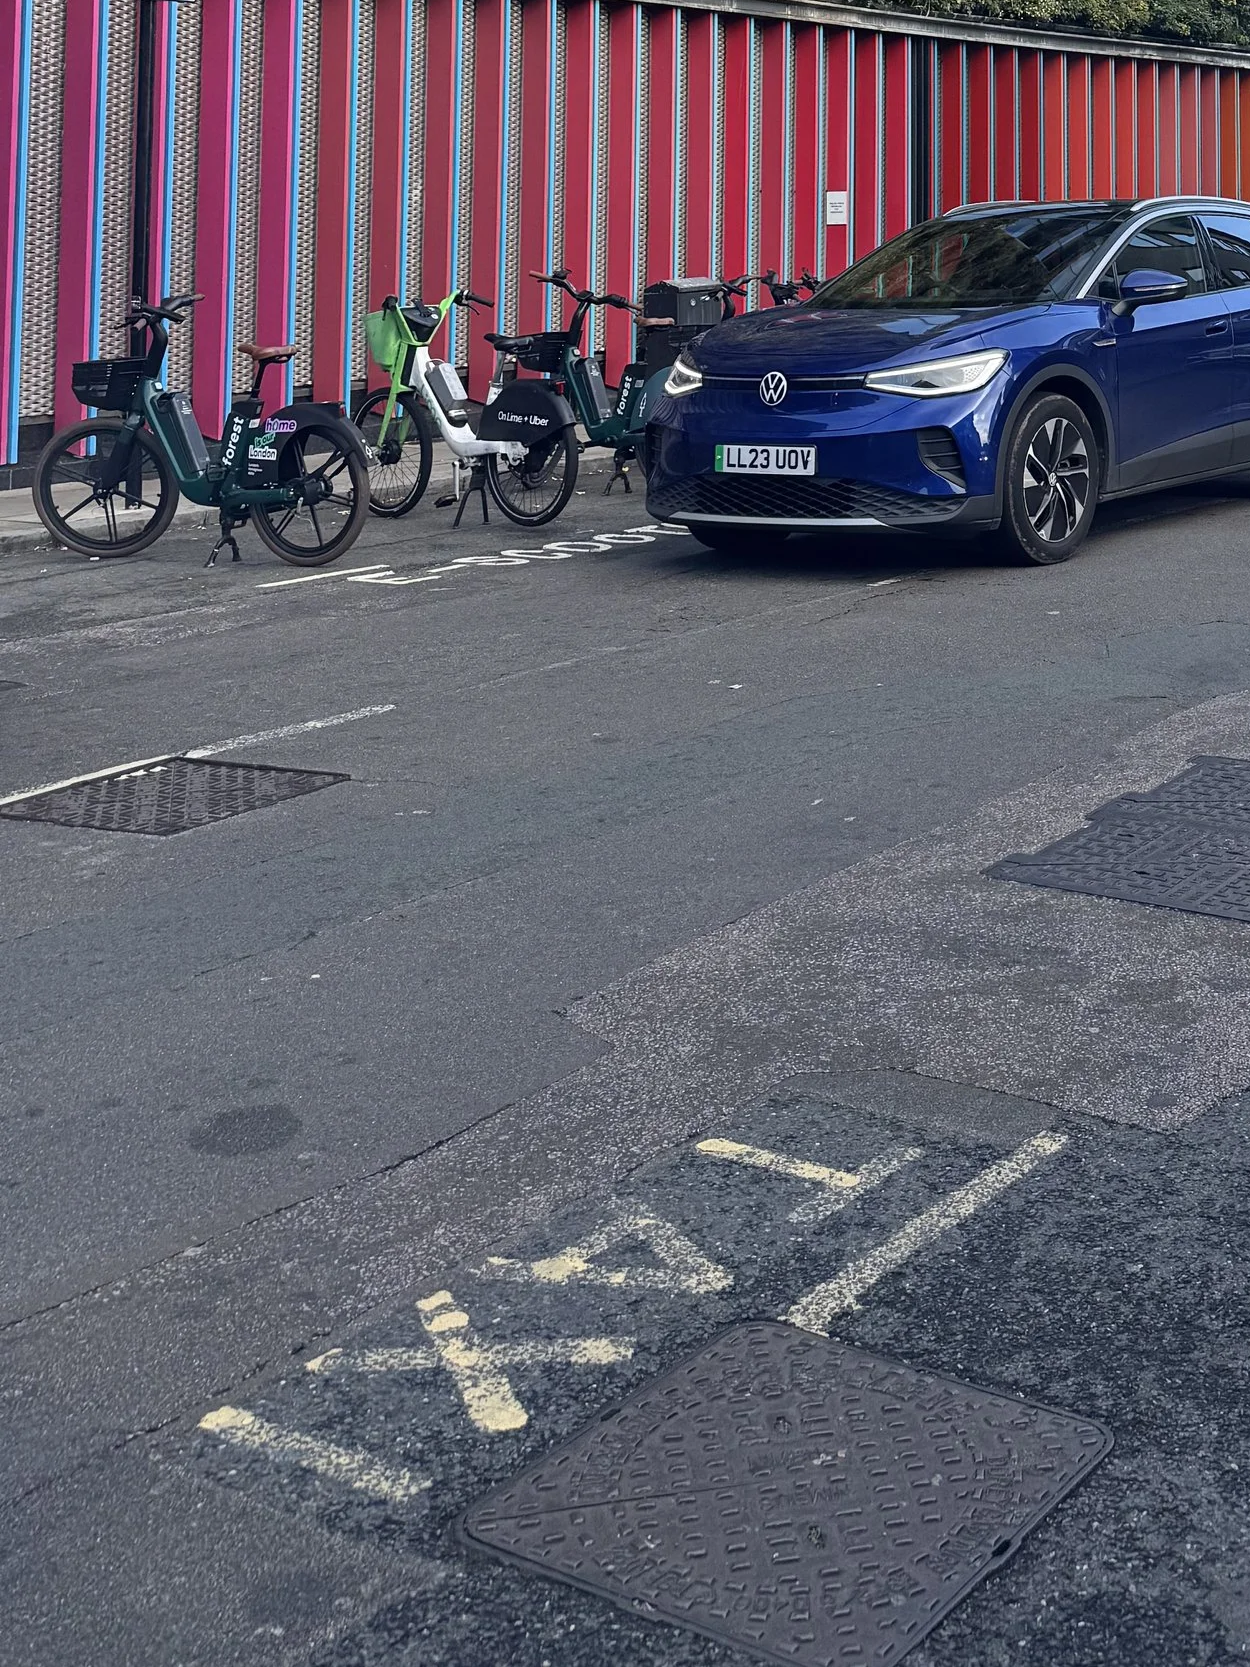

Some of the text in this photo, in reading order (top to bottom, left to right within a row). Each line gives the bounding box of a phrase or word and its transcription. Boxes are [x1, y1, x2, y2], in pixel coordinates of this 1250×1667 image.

[617, 375, 633, 415] forest
[497, 410, 507, 421] On
[507, 412, 523, 423] Lime
[529, 415, 550, 426] Uber
[221, 416, 245, 466] forest
[249, 446, 276, 459] London
[262, 433, 276, 445] our
[726, 447, 811, 470] LL23 UOV
[347, 522, 693, 585] E-SCOOT
[199, 1131, 923, 1502] TAXI
